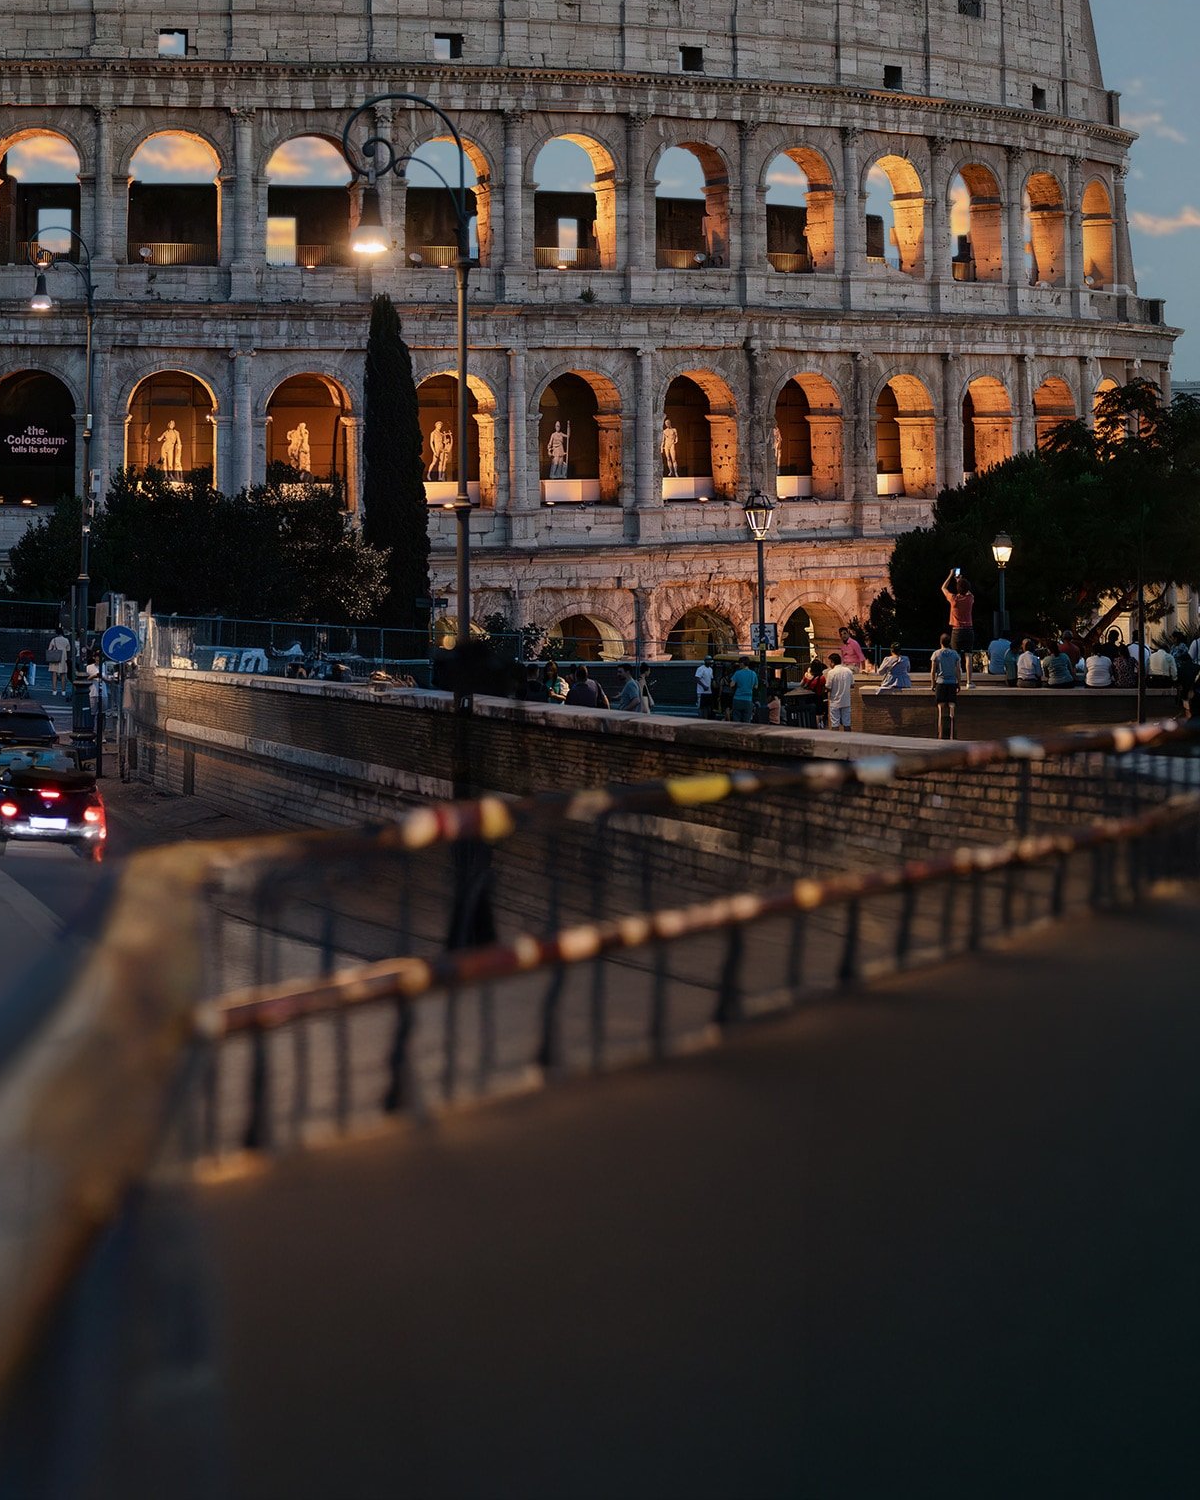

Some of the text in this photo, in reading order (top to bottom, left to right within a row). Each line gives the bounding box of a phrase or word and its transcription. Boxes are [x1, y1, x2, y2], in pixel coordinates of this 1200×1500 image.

[11, 445, 59, 455] tells its story
